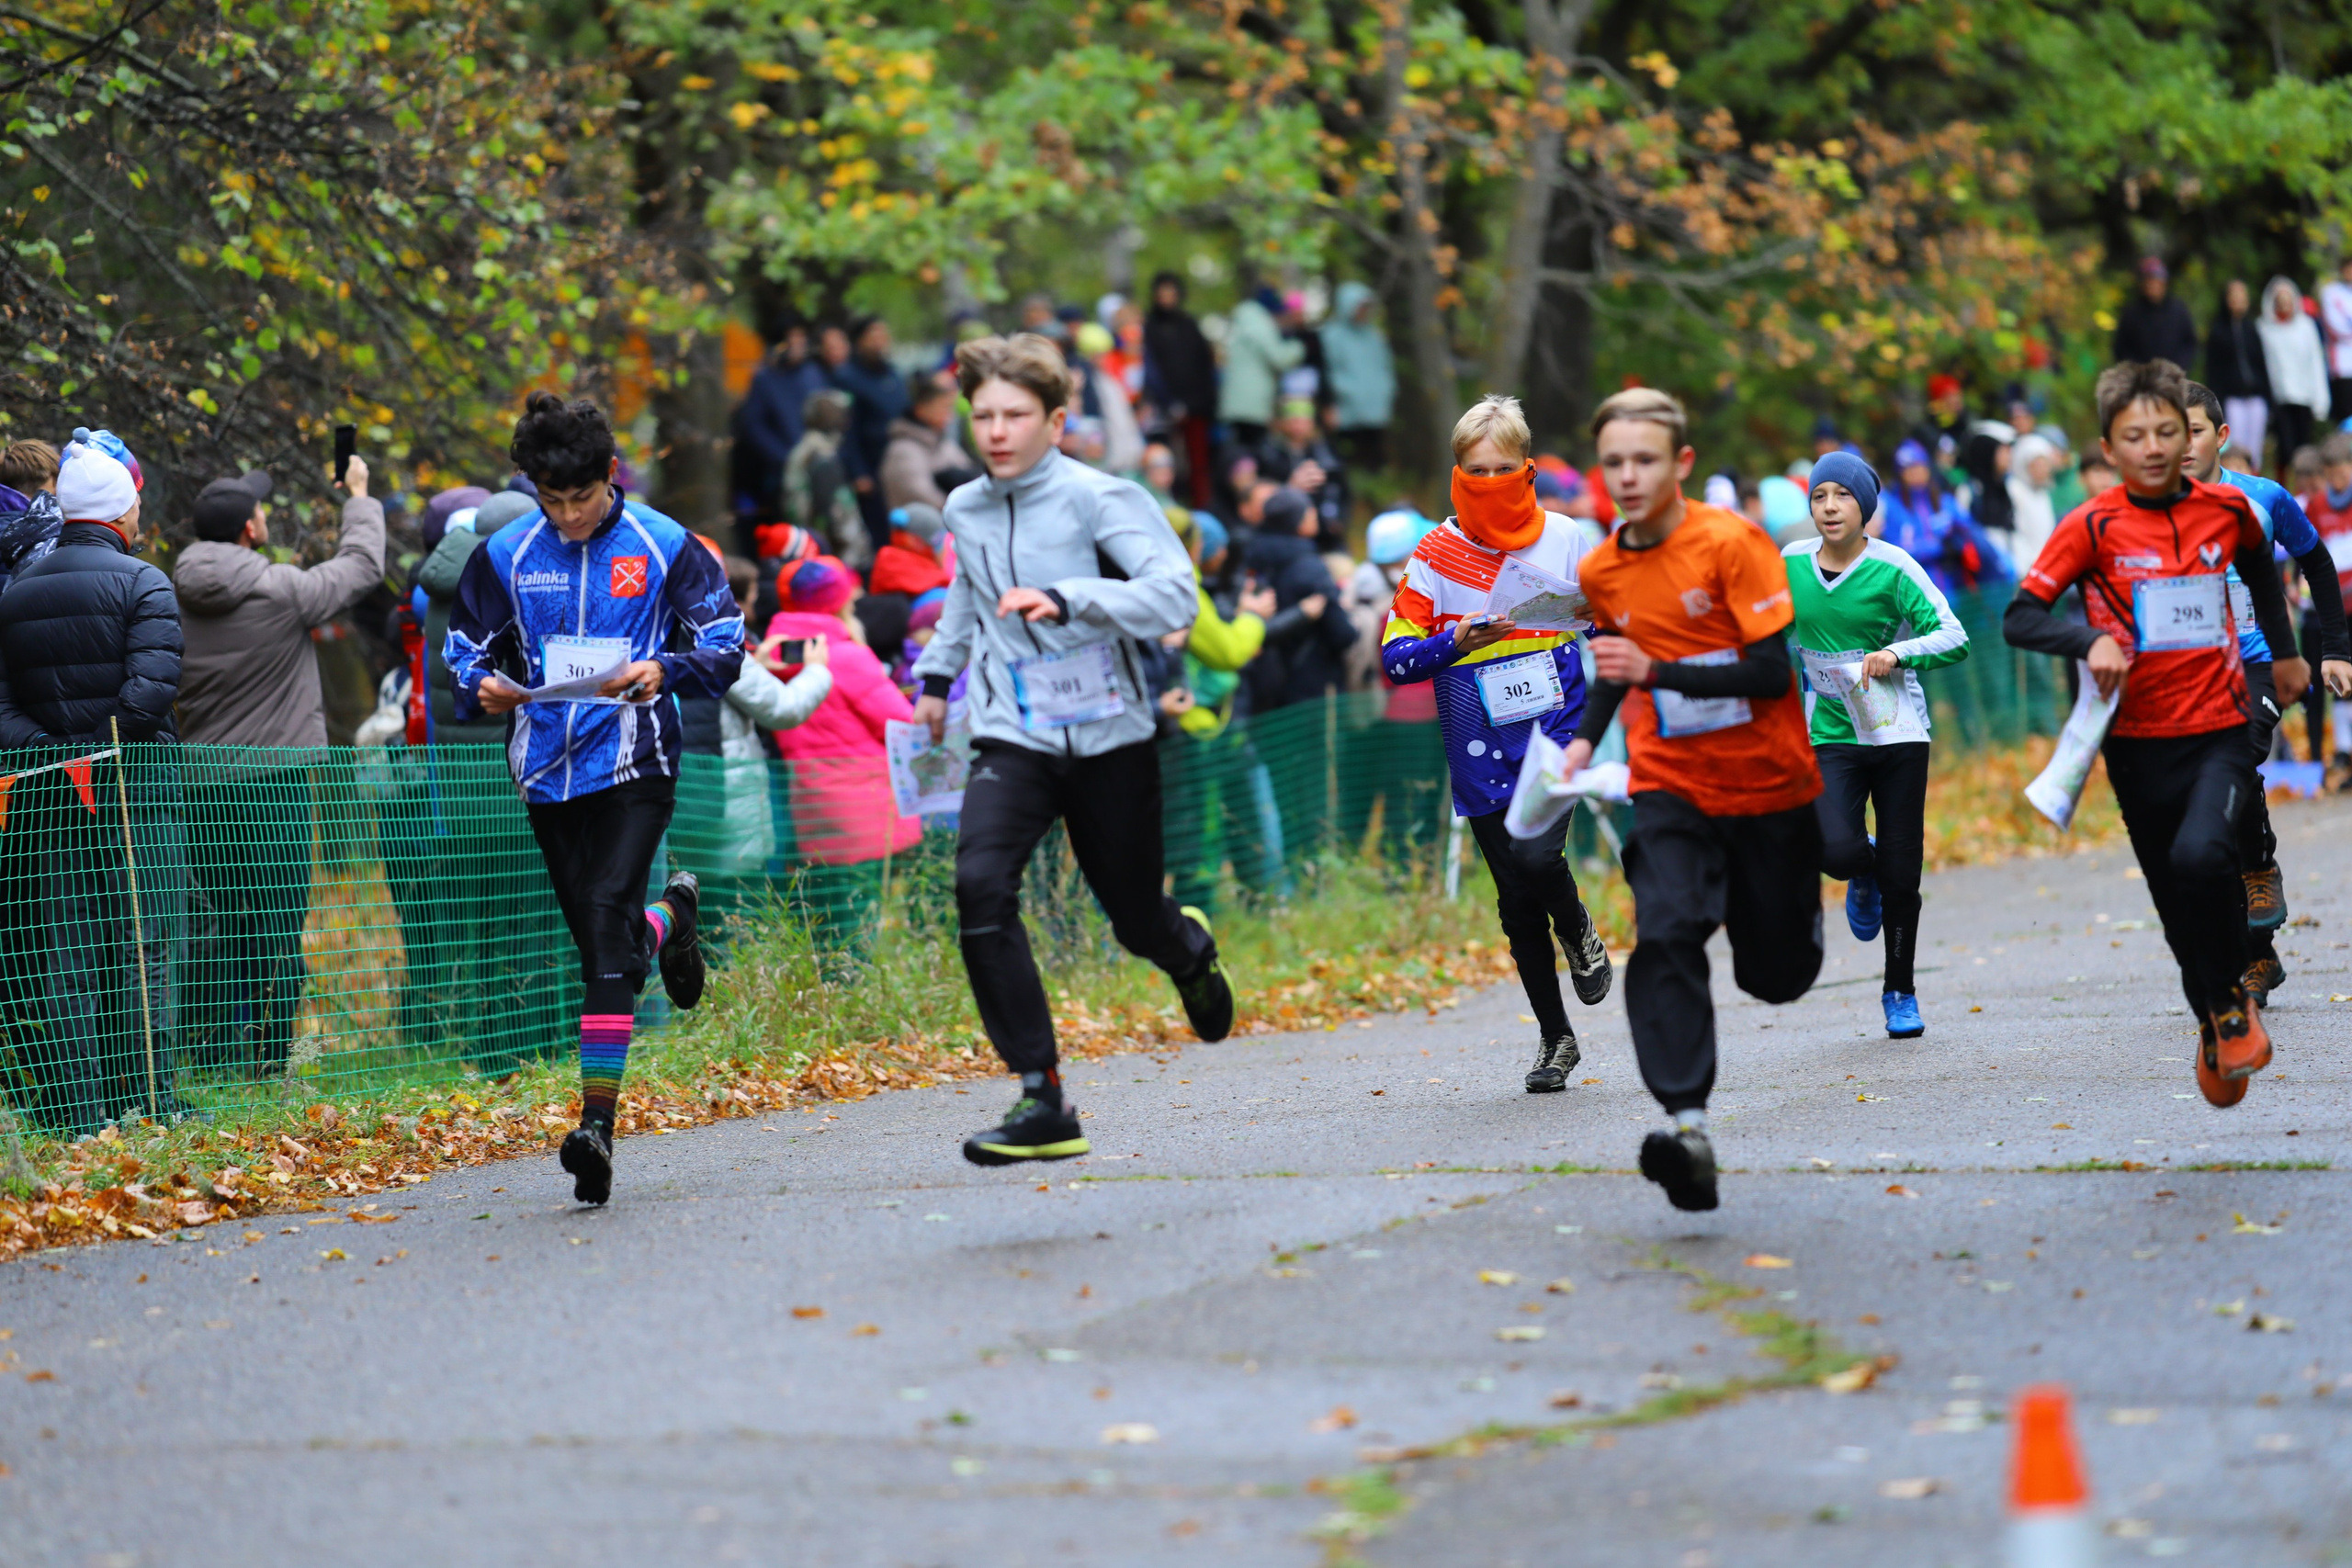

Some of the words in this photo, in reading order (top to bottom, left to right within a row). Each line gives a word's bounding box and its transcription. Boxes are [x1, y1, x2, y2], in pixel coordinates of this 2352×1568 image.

[517, 570, 569, 587] kalinka
[2173, 605, 2203, 624] 298
[1504, 682, 1532, 701] 302
